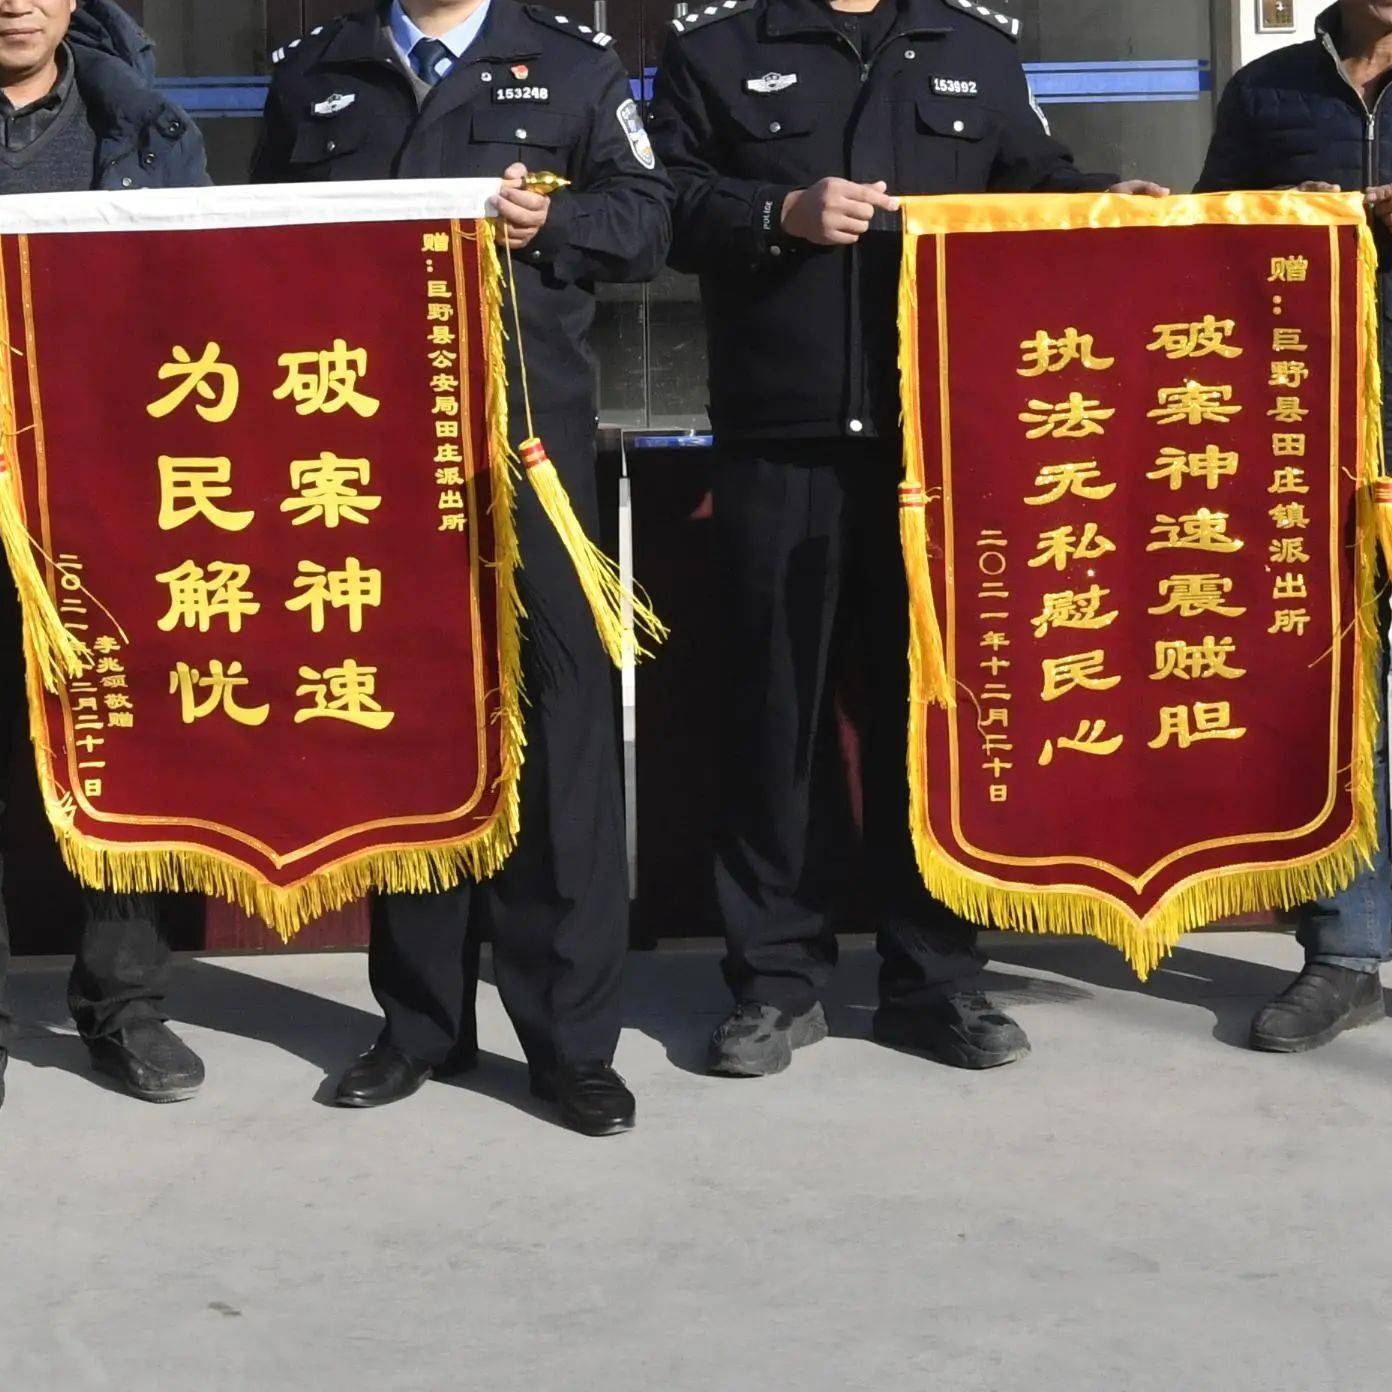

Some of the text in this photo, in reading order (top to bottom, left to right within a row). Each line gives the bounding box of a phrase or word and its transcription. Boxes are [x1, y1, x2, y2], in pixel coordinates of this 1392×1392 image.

[144, 340, 269, 729] 为民解忧
[272, 337, 395, 731] 破案神速
[1015, 326, 1124, 767] 执法无私慰民心
[1145, 313, 1247, 750] 破案神速震贼胆
